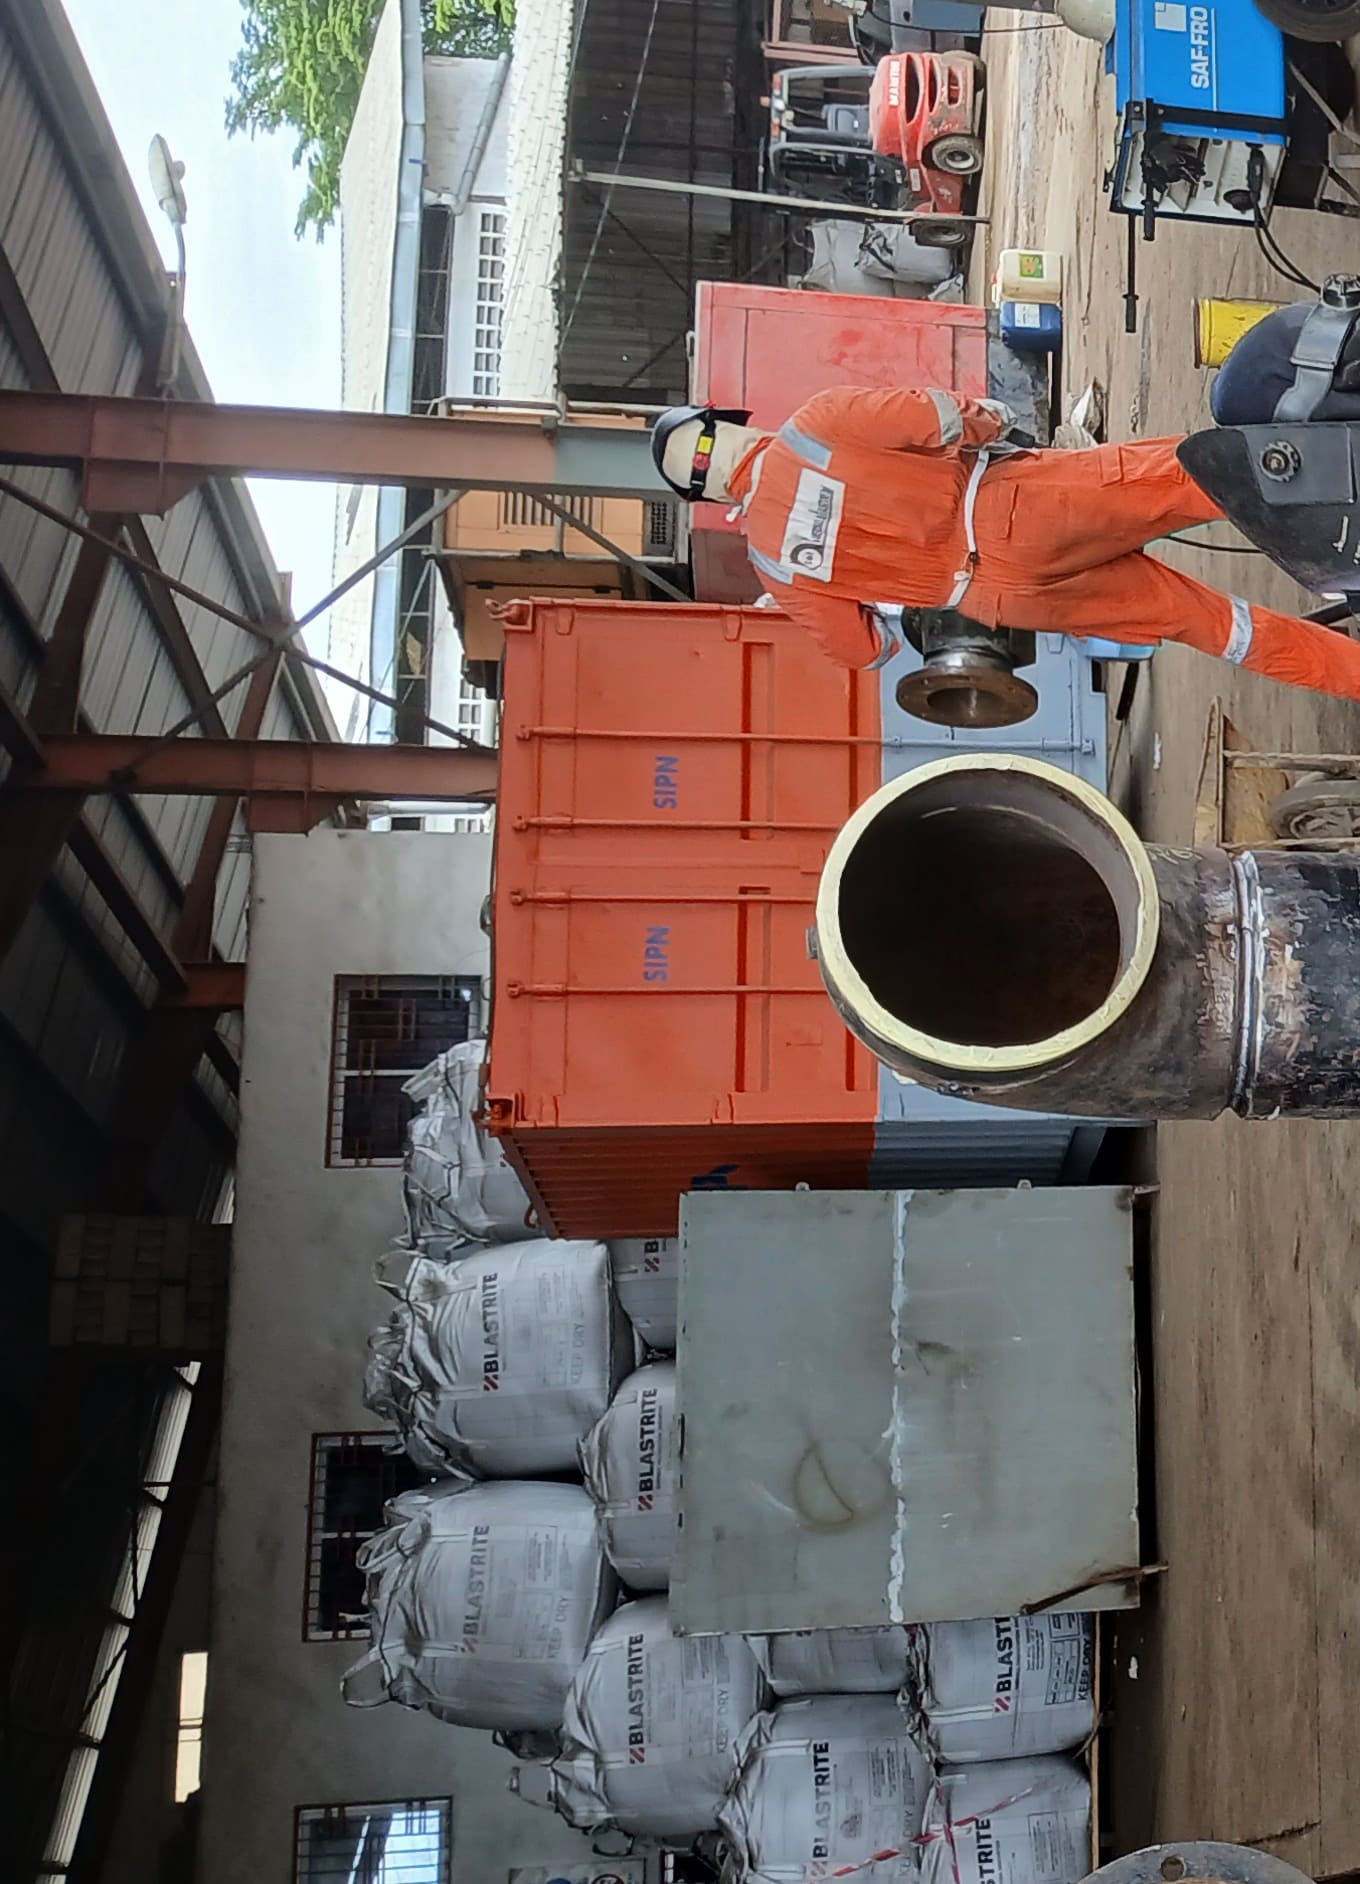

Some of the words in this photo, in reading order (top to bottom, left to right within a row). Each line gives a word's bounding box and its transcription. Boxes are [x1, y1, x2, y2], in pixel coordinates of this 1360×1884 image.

[653, 756, 679, 809] SIPN
[643, 925, 671, 982] SIPN
[482, 1272, 499, 1373] BLASTRITE
[639, 1388, 657, 1492] BLASTRITE
[463, 1525, 490, 1634] BLASTRITE
[628, 1634, 644, 1745] BLASTRITE
[812, 1742, 831, 1857] BLASTRITE
